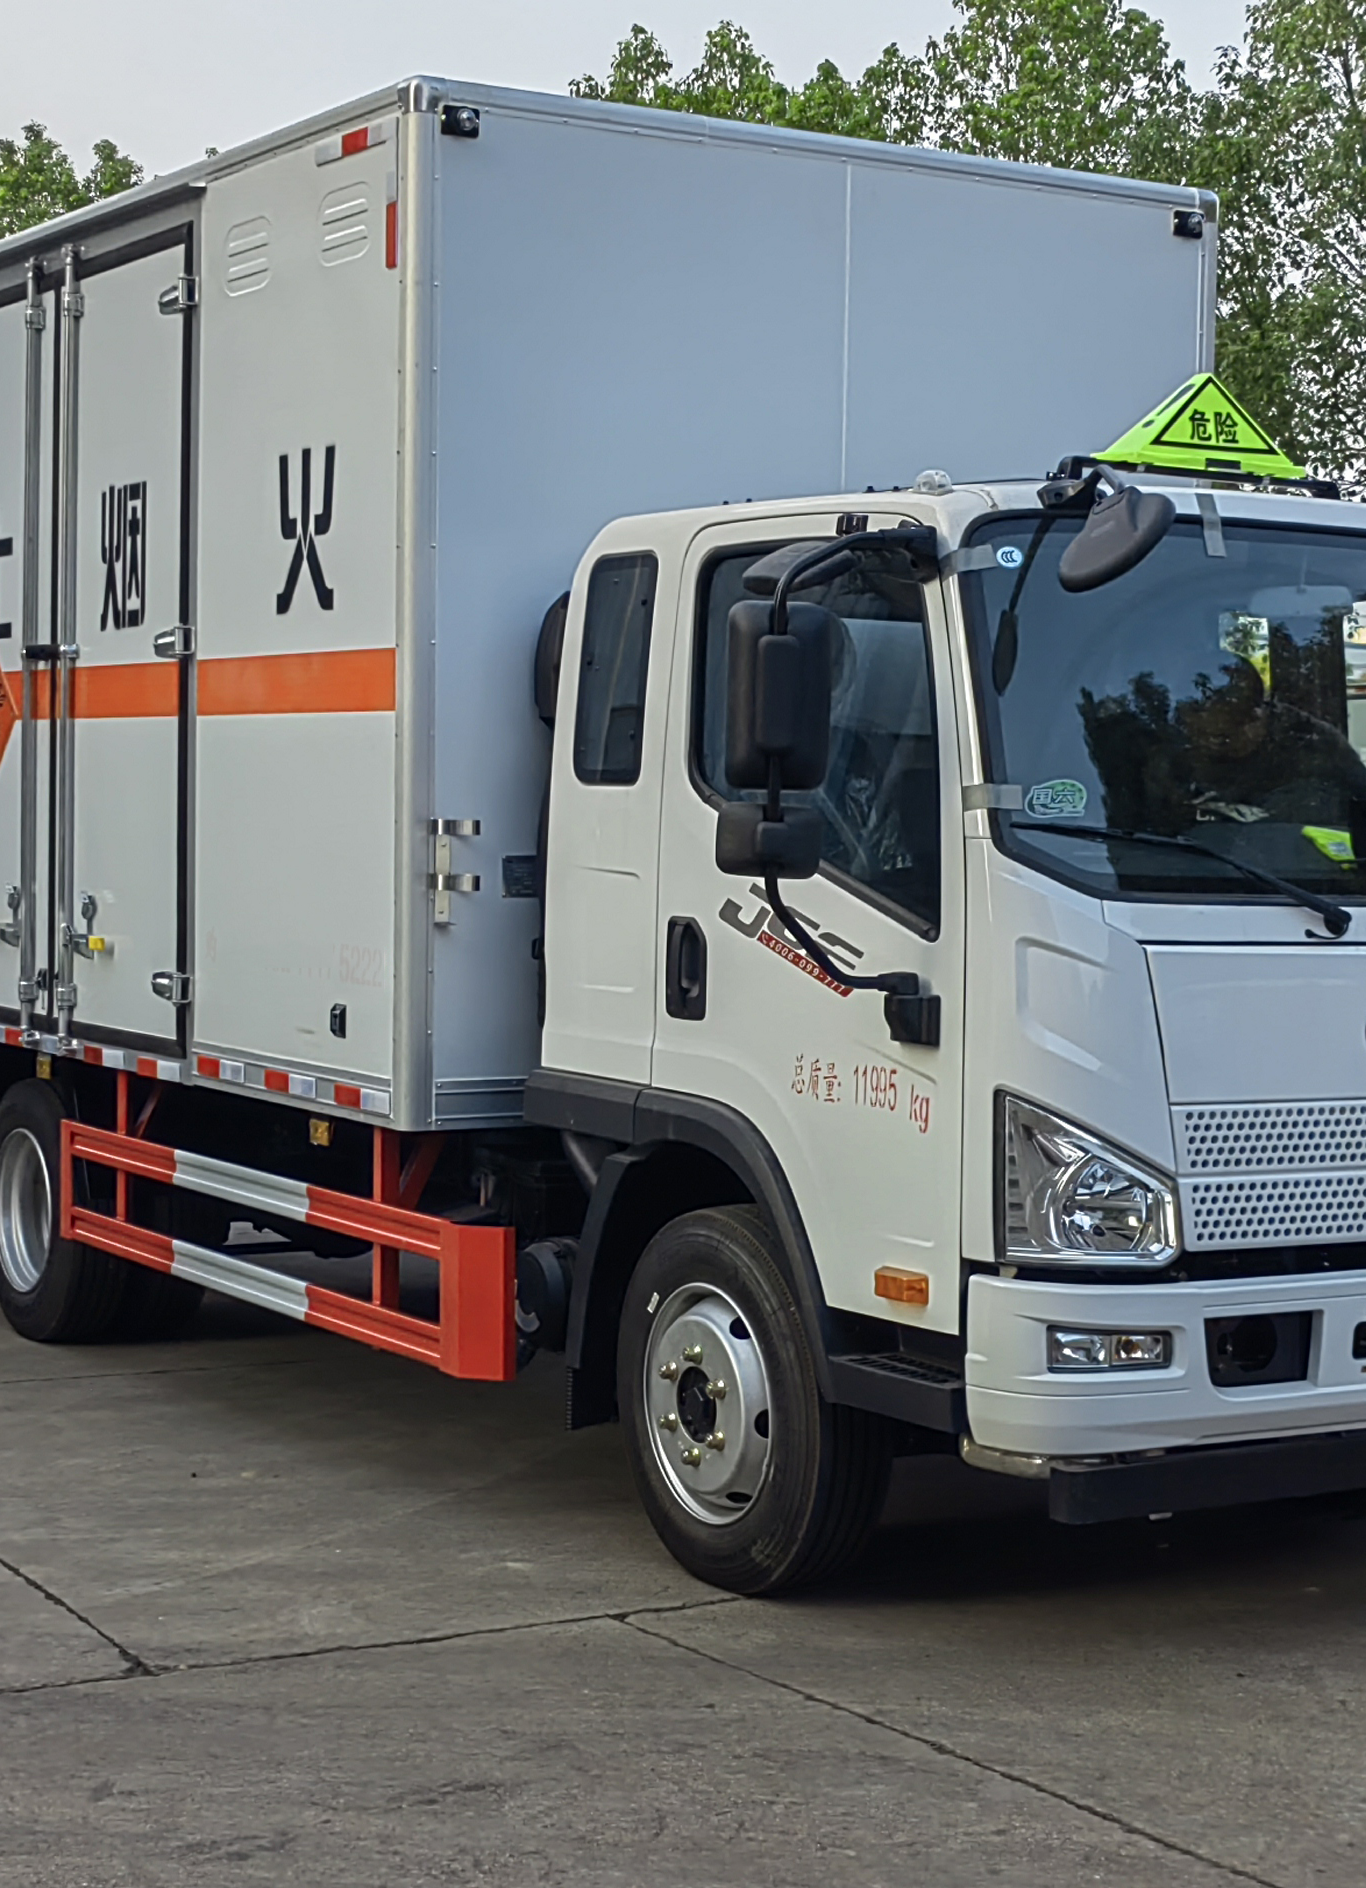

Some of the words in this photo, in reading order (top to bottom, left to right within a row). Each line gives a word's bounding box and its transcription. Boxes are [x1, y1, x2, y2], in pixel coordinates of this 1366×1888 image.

[1188, 408, 1240, 444] 危险
[1032, 786, 1076, 805] 国六
[853, 1063, 898, 1112] 11995
[908, 1084, 931, 1134] kg
